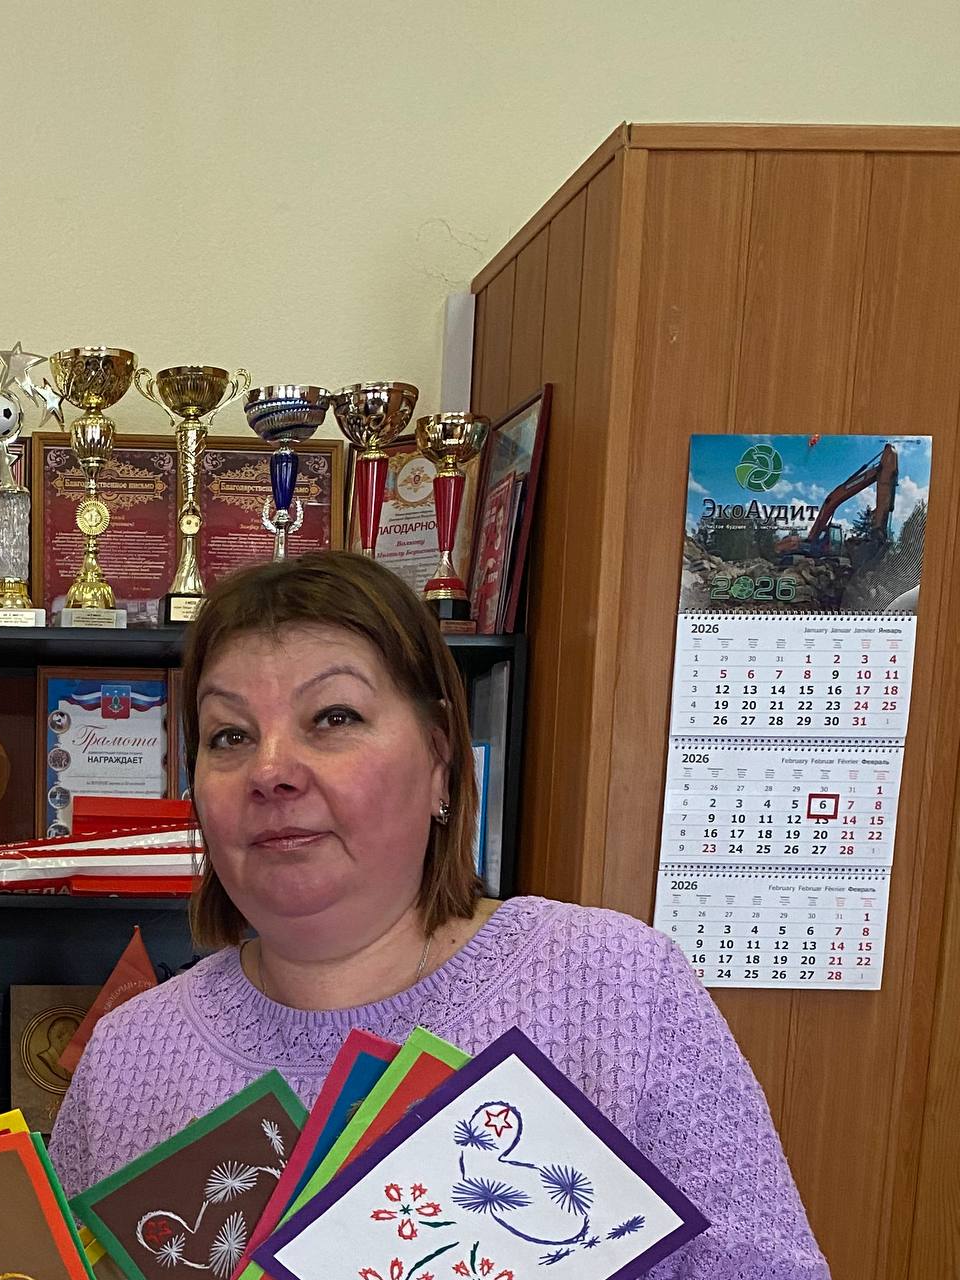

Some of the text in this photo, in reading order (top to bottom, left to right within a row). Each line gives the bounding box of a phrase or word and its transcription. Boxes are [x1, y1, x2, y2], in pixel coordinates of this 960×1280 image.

[701, 498, 819, 525] ЭкоАудит
[691, 624, 719, 634] 2026
[806, 655, 811, 663] 1
[834, 655, 840, 663] 2
[862, 655, 868, 663] 3
[890, 655, 896, 663] 4
[720, 670, 898, 679] 5 6 7 8 9 10 11
[716, 685, 898, 695] 12 13 14 15 16 17 18
[715, 701, 896, 710] 19 20 21 22 23 24 25
[713, 716, 866, 726] 26 27 28 29 30 31
[72, 724, 158, 753] Грамота
[88, 756, 143, 765] НАГРАЖДАЕТ
[682, 753, 709, 763] 2026
[877, 786, 882, 794] 1
[710, 799, 881, 810] 2 3 4 5 6 7 8
[709, 814, 715, 822] 9
[732, 815, 745, 823] 10
[759, 815, 773, 823] 11
[787, 815, 801, 824] 12
[843, 816, 856, 824] 14
[870, 816, 884, 825] 15
[704, 829, 882, 840] 16 17 18 19 20 21 22
[702, 844, 853, 855] 23 24 25 26 27 28
[671, 881, 698, 890] 2026
[698, 925, 869, 936] 2 3 4 5 6 7 8
[692, 954, 870, 965] 16 17 18 19 20 21 22
